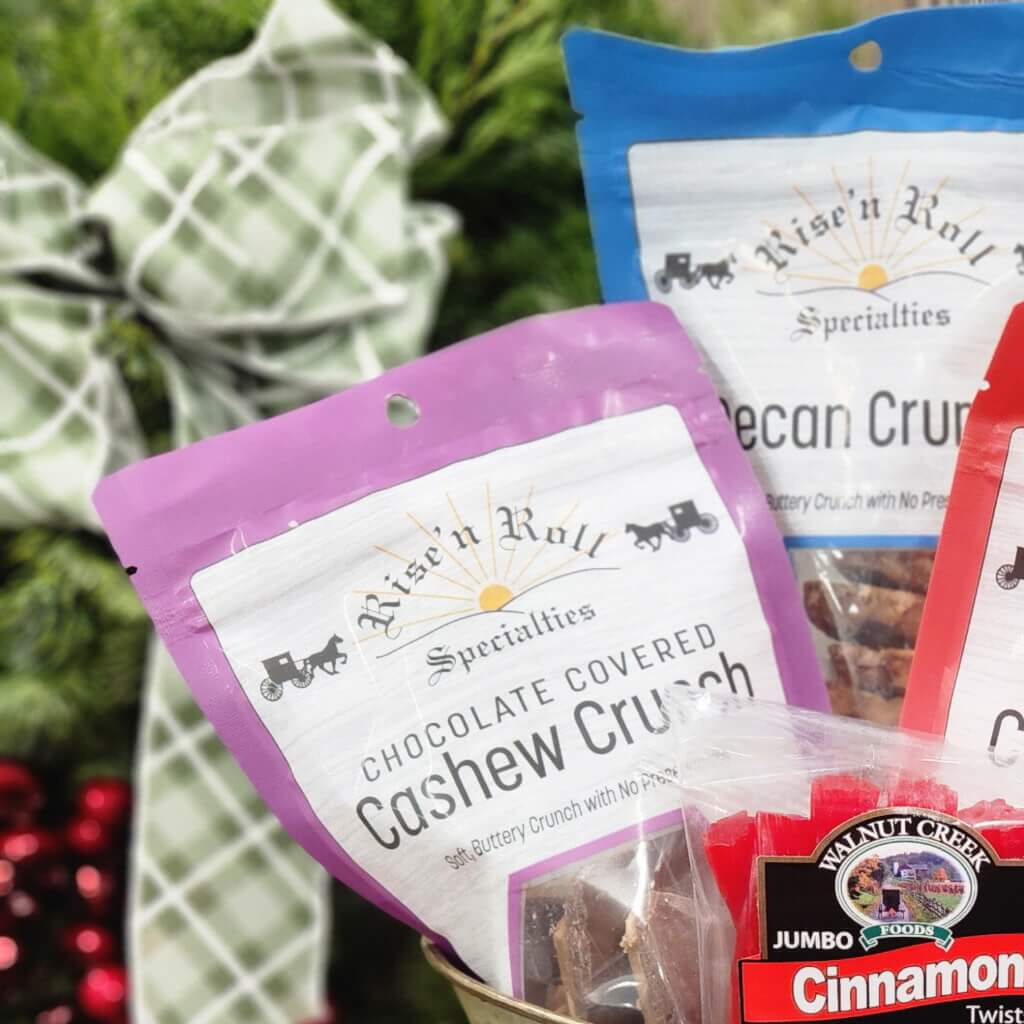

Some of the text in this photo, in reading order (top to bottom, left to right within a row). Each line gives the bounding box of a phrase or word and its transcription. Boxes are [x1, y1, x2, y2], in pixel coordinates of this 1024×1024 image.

[754, 186, 998, 283] Rise'n Roll
[790, 302, 951, 342] Specialties
[814, 492, 863, 511] Crunch
[867, 490, 896, 511] with
[900, 491, 918, 510] No
[357, 505, 608, 640] Rise'n Roll
[426, 601, 597, 687] Specialties
[361, 622, 718, 783] CHOCOLATE COVERED
[355, 651, 755, 850] Cashew Cruh
[471, 822, 526, 857] Buttery
[529, 799, 583, 834] Crunch
[584, 785, 617, 813] with
[618, 778, 639, 797] No
[817, 816, 992, 875] WALNUT CREEK
[771, 930, 854, 951] JUMBO
[880, 923, 936, 938] FOODS
